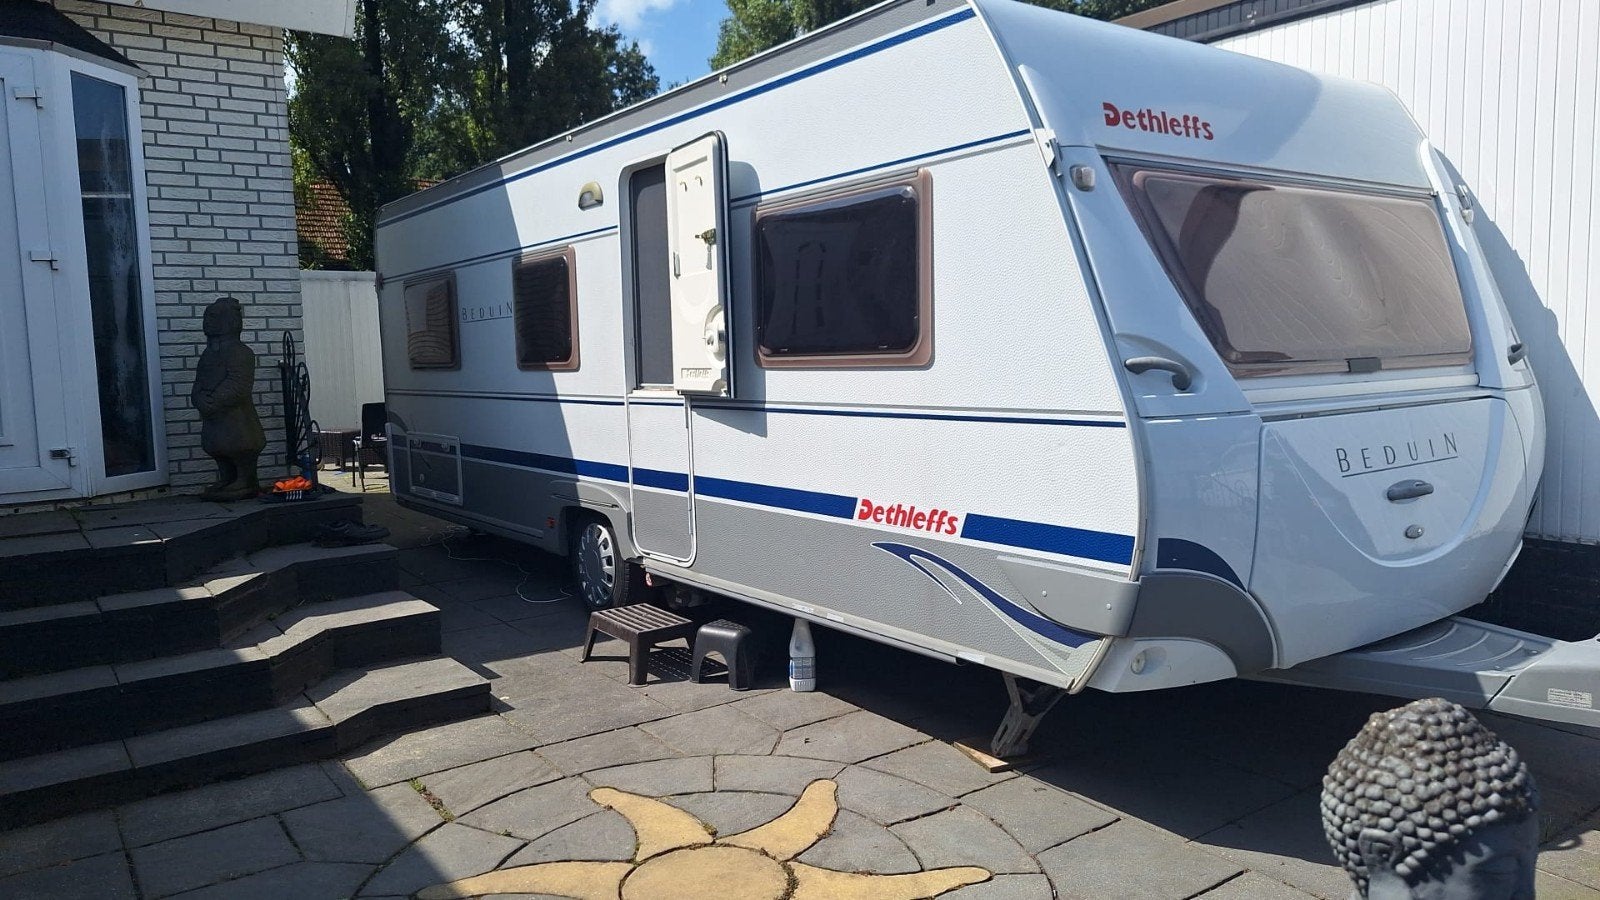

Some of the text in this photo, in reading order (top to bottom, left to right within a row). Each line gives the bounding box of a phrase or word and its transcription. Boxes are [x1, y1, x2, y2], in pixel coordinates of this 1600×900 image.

[1102, 101, 1214, 141] Dethleffs
[461, 301, 513, 321] BEDUIN
[1335, 432, 1458, 473] BEDUIN
[858, 499, 958, 535] Dethleffs
